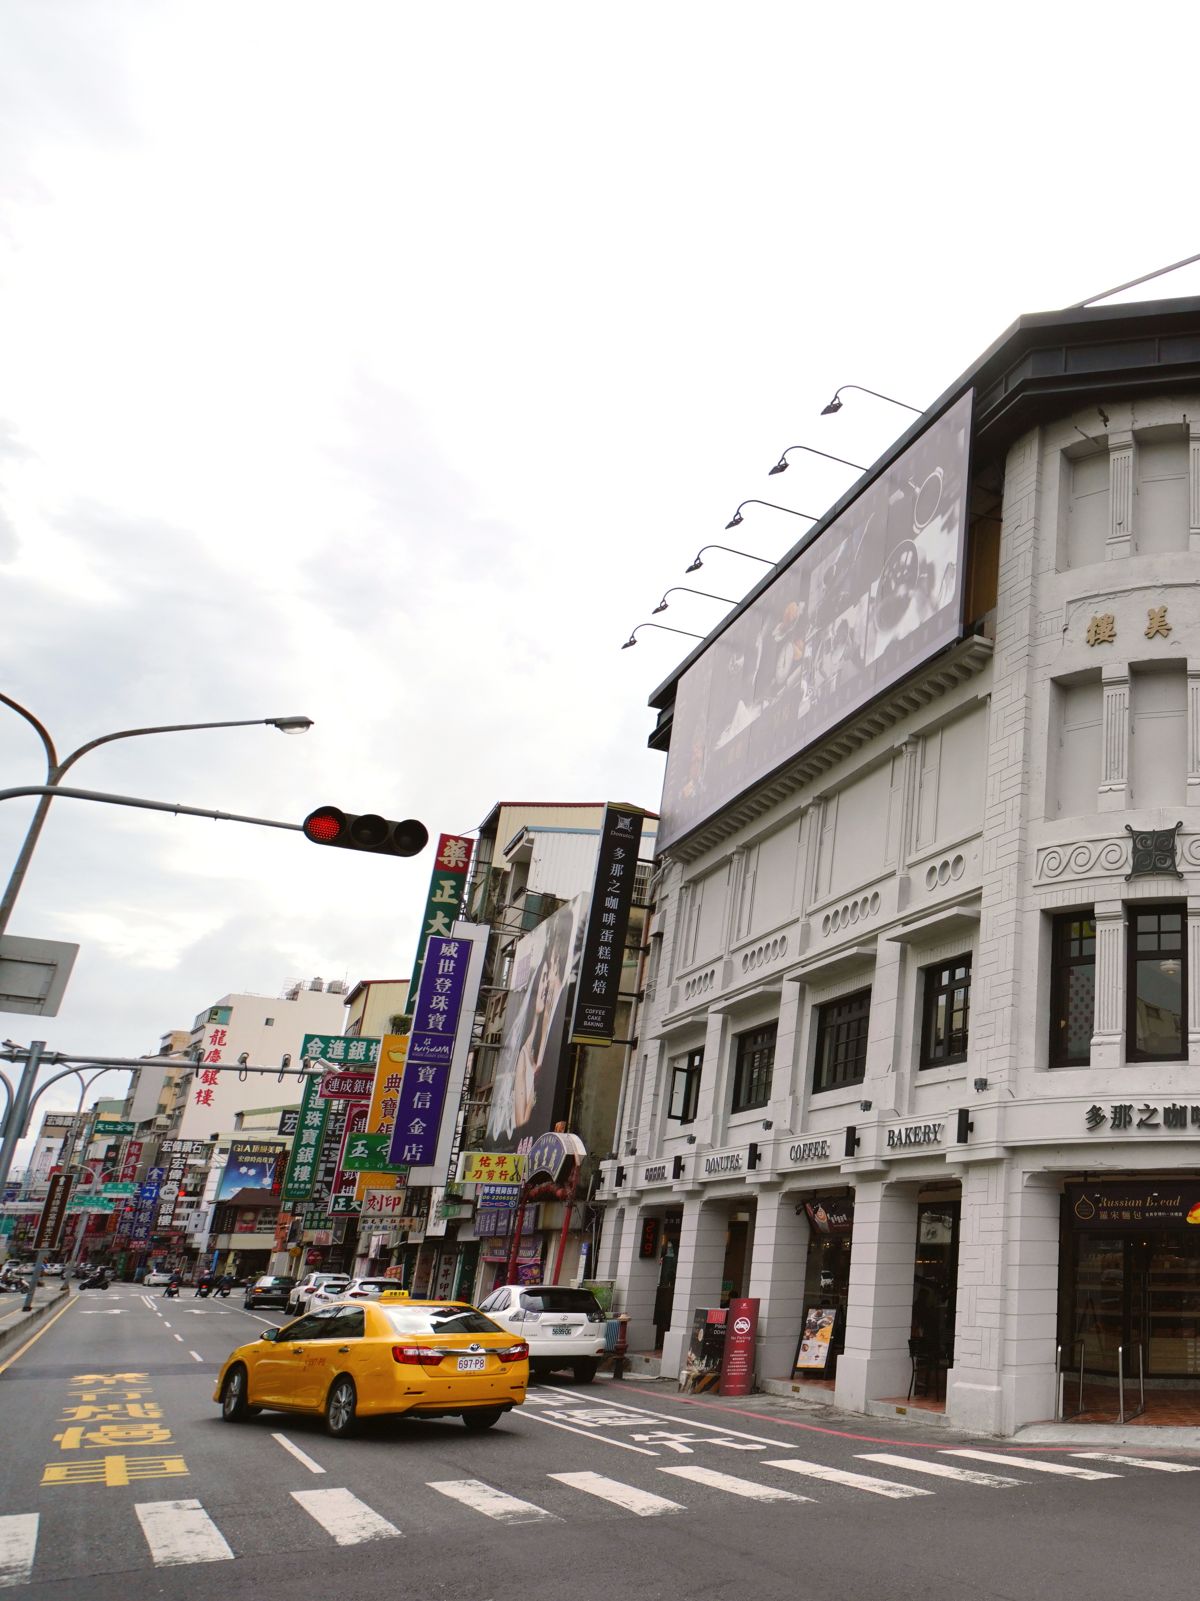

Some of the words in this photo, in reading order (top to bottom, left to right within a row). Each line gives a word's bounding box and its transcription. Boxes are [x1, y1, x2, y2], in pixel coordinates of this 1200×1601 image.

[592, 847, 626, 994] 多那之咖啡蛋糕烘焙
[427, 941, 459, 1031] 威世登珠寶
[585, 1008, 606, 1016] COFFEE
[402, 1065, 437, 1161] 寶信金店
[887, 1123, 944, 1148] BAKERY
[789, 1140, 830, 1162] COFFEE
[705, 1154, 742, 1174] DONUTES
[366, 1194, 402, 1212] 刻印
[458, 1359, 485, 1369] 697-P8
